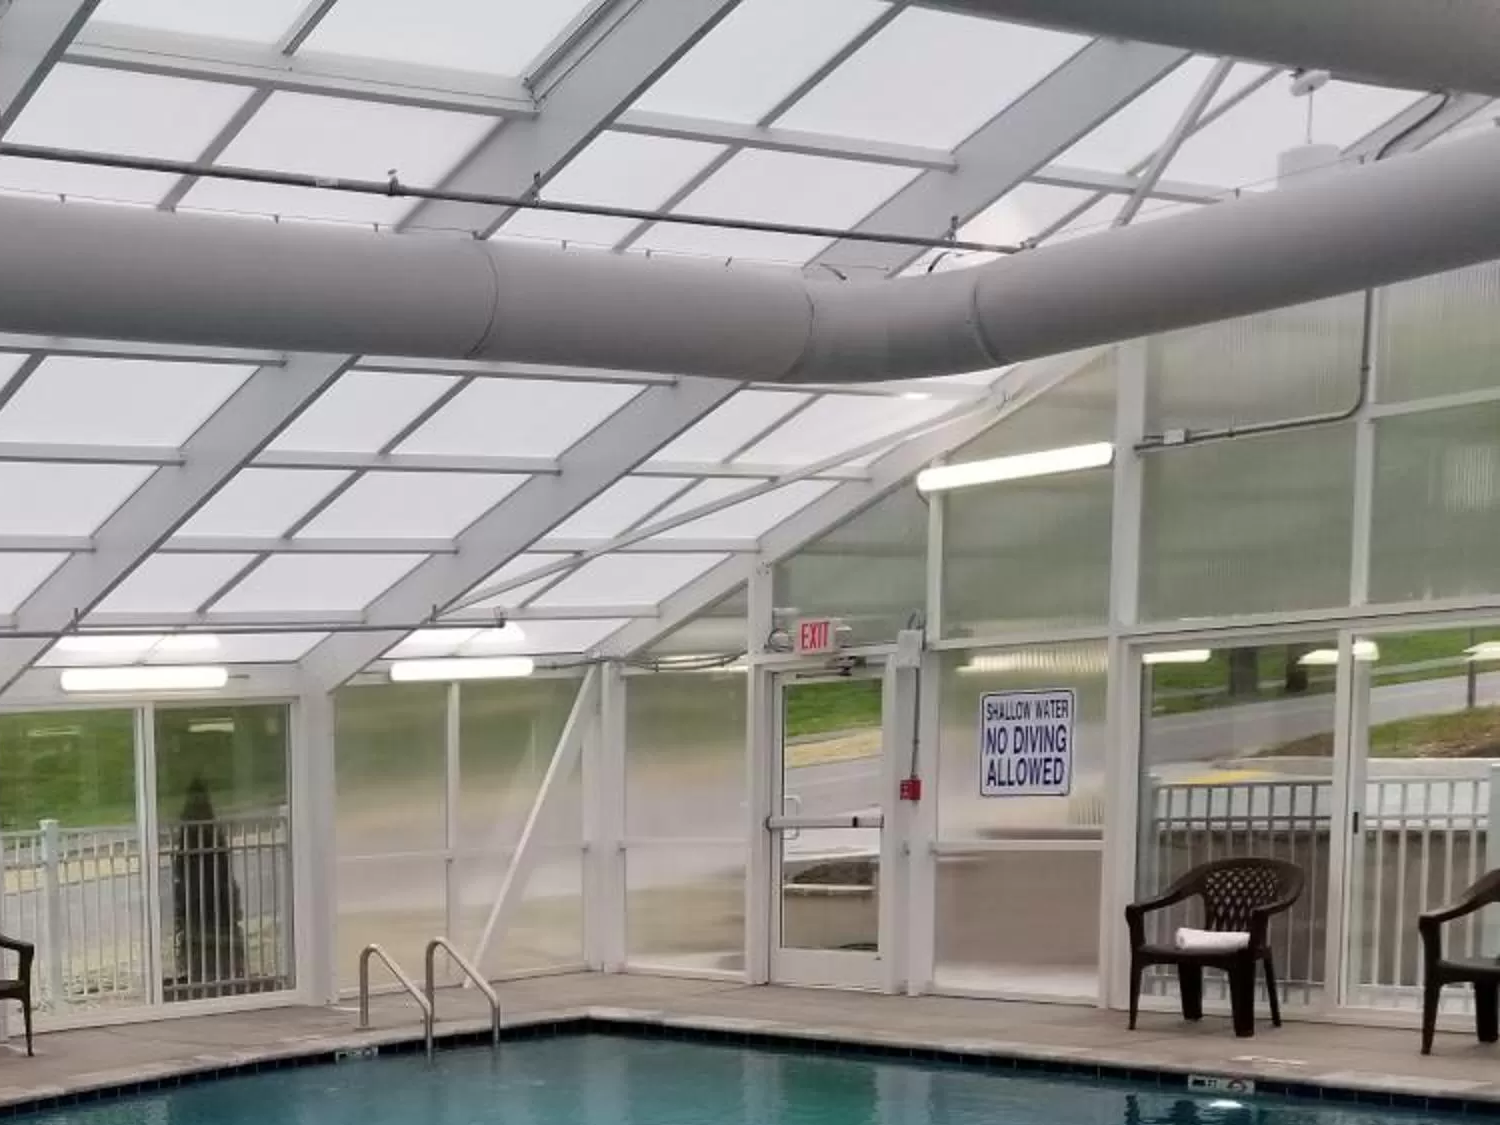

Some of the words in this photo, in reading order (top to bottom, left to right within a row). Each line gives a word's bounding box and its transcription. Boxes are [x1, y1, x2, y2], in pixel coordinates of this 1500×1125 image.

[801, 622, 829, 649] EXIT
[987, 701, 1030, 720] SHALLOW
[1035, 699, 1068, 719] WATER
[986, 726, 1008, 754] NO
[1013, 724, 1067, 754] DIVING
[986, 757, 1065, 786] ALLOWED
